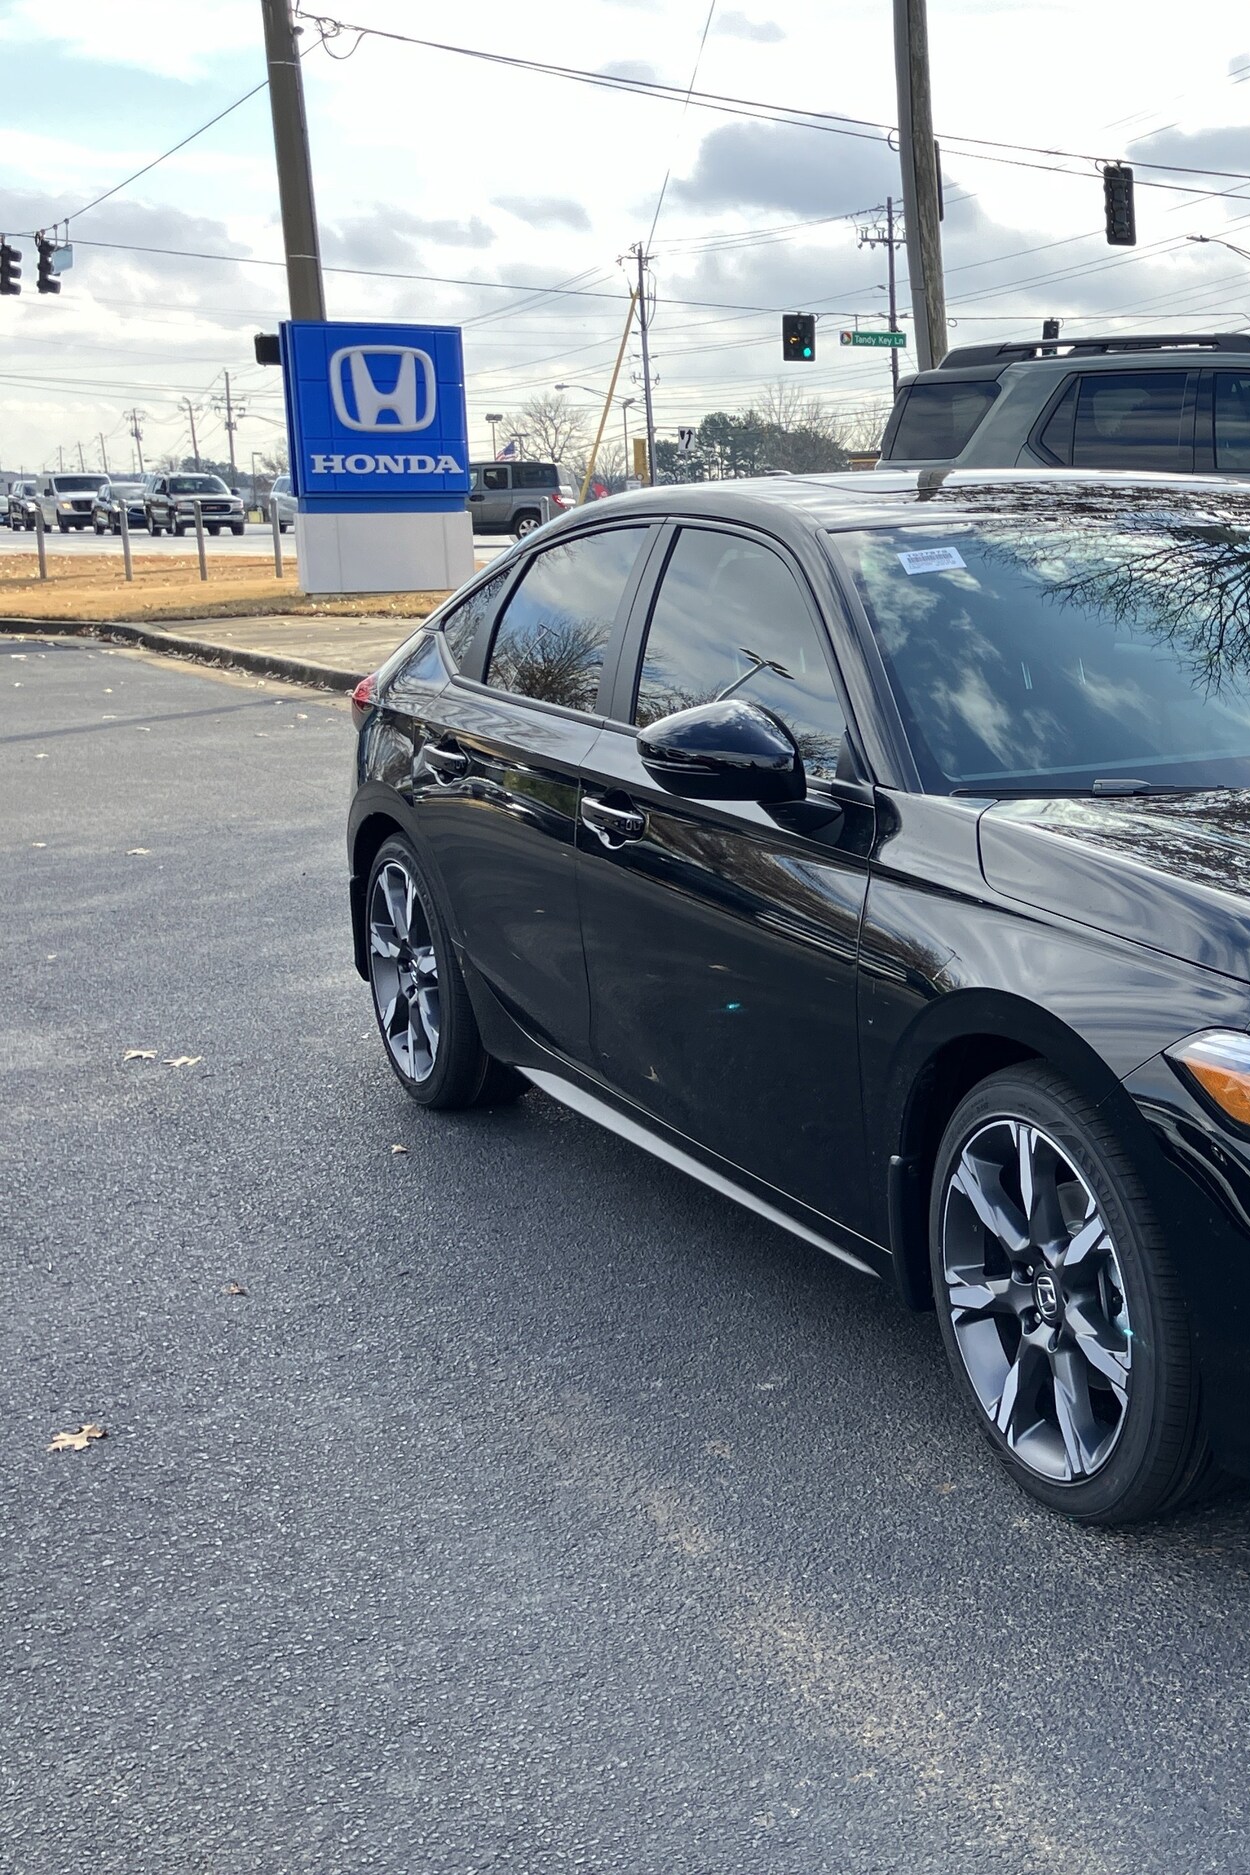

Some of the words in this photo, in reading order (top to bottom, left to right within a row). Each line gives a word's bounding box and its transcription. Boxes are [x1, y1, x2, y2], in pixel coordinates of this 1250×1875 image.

[854, 335, 876, 346] Tandy
[878, 336, 892, 346] Key
[894, 337, 904, 345] Ln
[310, 454, 464, 474] HONDA
